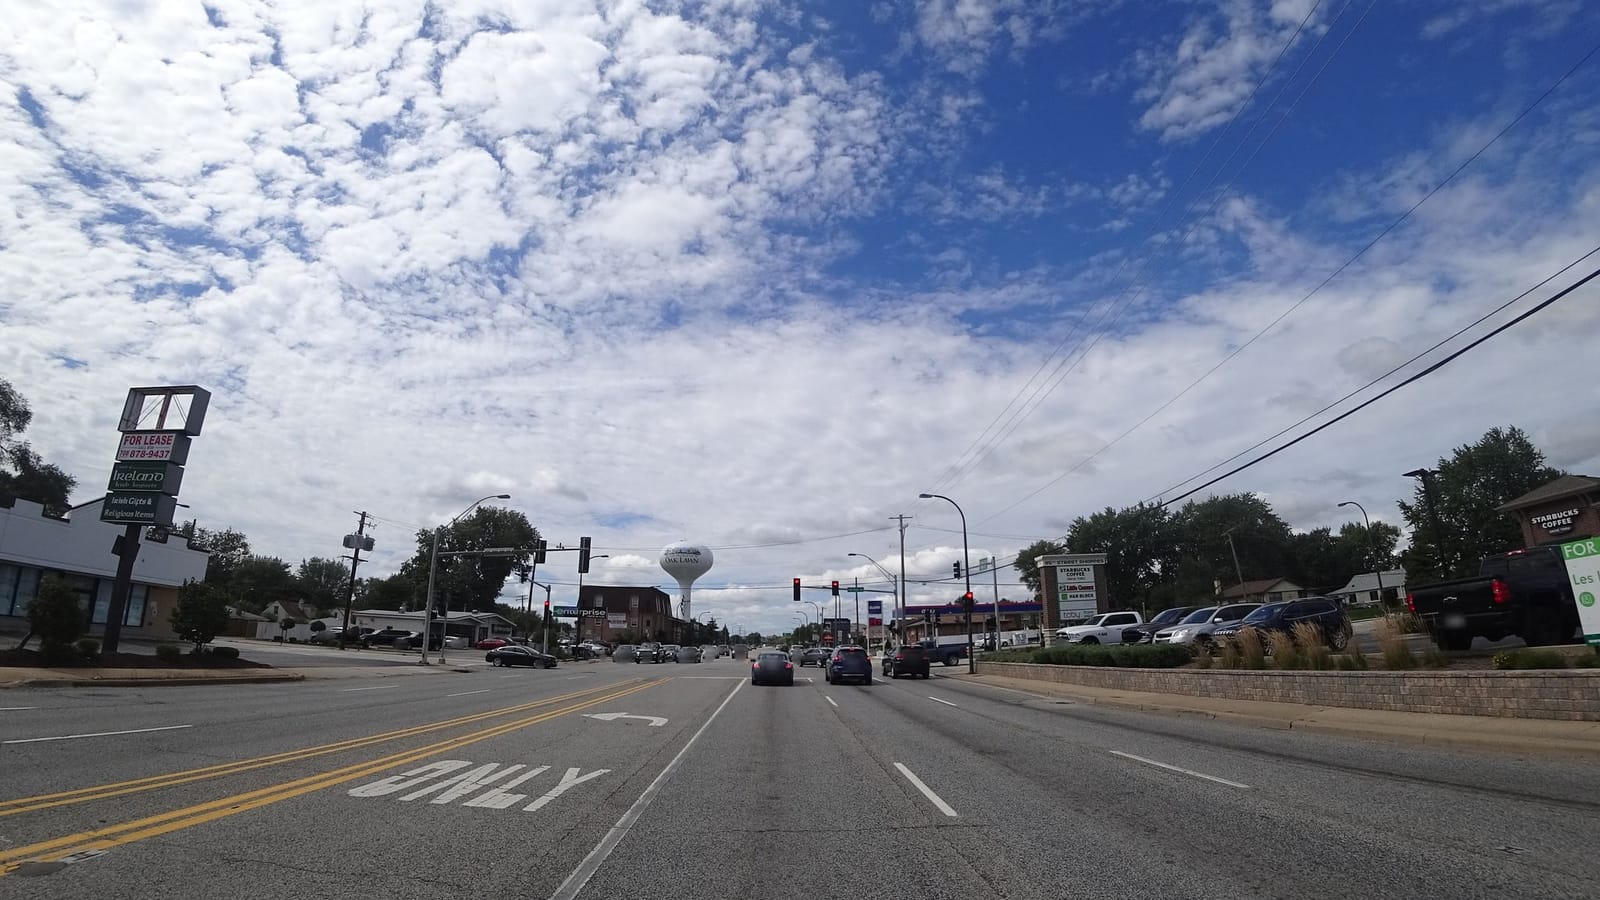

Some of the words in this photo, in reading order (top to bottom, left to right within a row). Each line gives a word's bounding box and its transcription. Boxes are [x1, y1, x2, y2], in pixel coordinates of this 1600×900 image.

[123, 435, 143, 445] FOR
[144, 435, 173, 445] LEASE
[129, 450, 170, 458] 878-9437
[112, 496, 128, 504] Irish
[128, 497, 146, 506] Gifts
[104, 509, 134, 518] Religious
[1531, 509, 1579, 524] STARBUCKS
[1542, 518, 1572, 528] COFFEE
[1563, 541, 1597, 558] FOR
[1573, 573, 1594, 585] Les
[347, 759, 612, 812] ONLY
